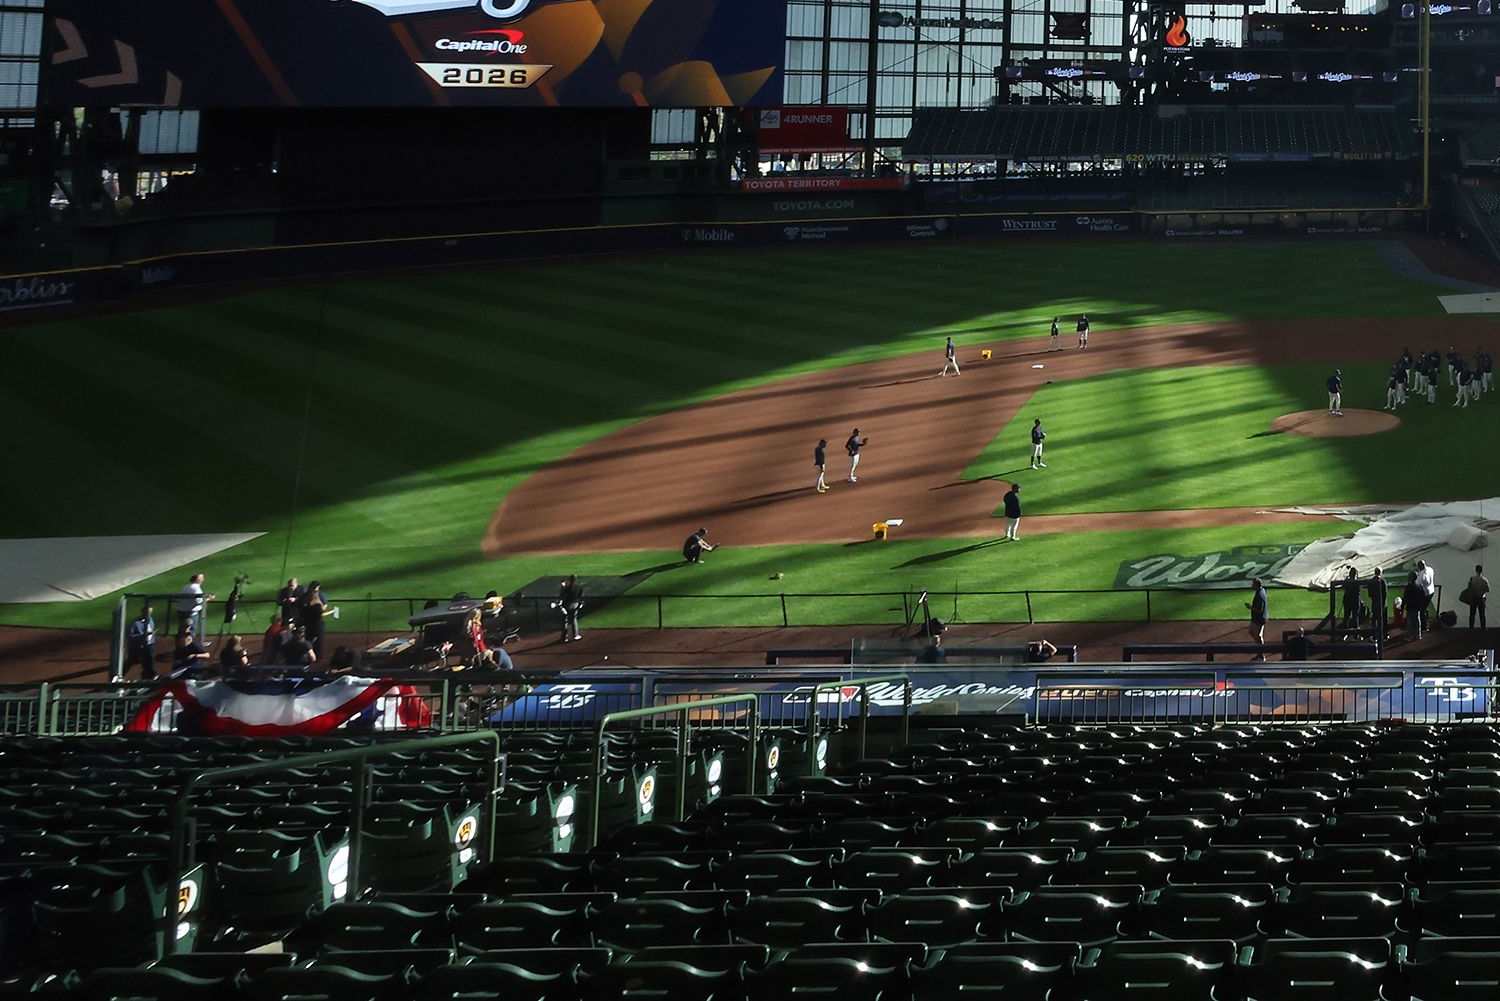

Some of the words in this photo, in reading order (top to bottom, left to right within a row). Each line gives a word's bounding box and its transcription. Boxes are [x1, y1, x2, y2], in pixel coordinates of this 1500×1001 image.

[442, 68, 528, 85] 2026
[784, 114, 833, 124] 4RUNNER
[1125, 154, 1144, 162] 620
[1146, 154, 1176, 162] WTMJ
[745, 180, 785, 189] TOYOTA
[787, 178, 842, 188] TERRITORY
[773, 200, 855, 211] TOYOTA.COM
[1089, 217, 1114, 225] Aurora
[1089, 224, 1113, 232] Health
